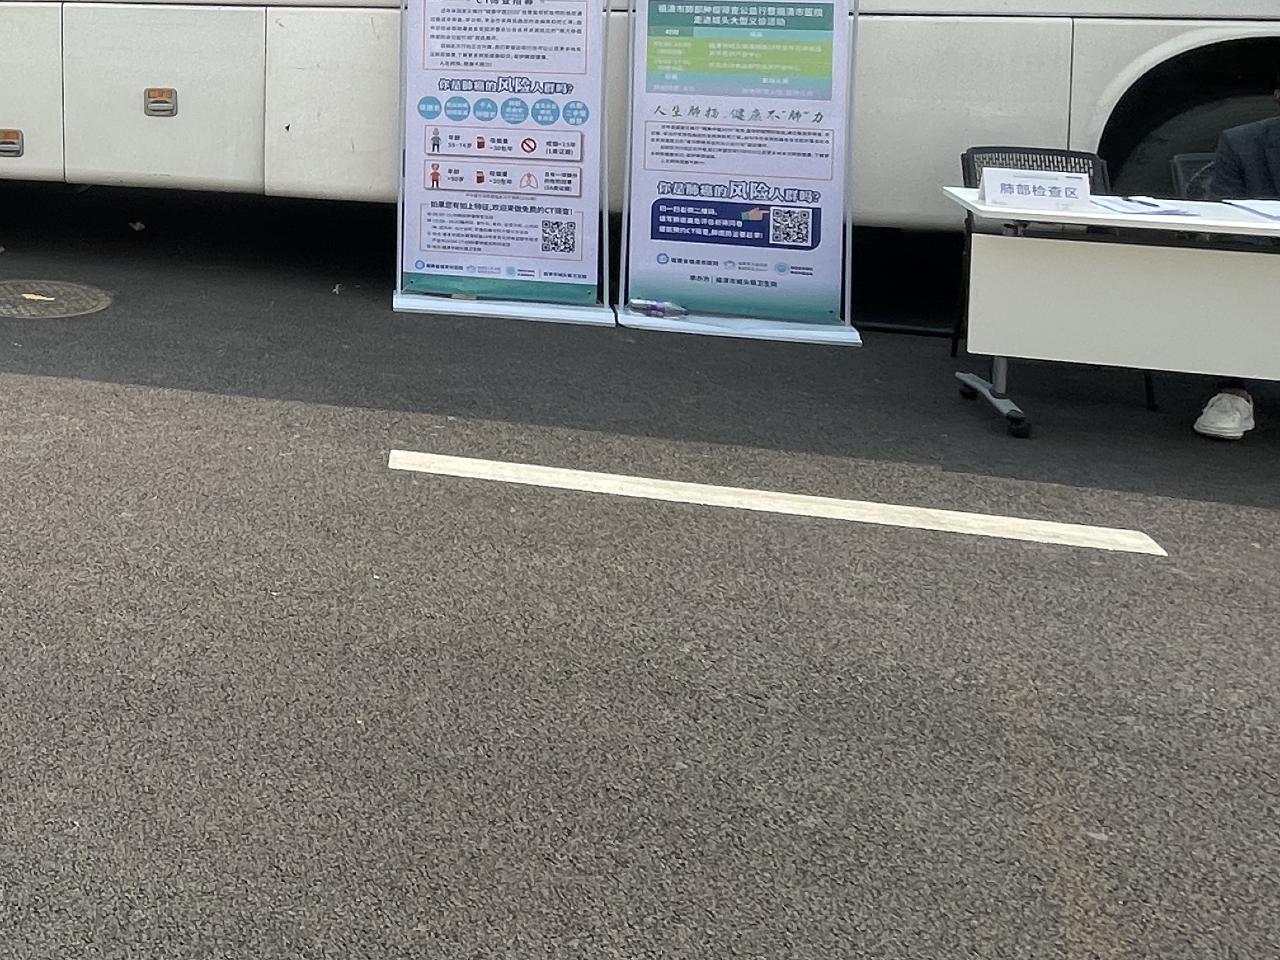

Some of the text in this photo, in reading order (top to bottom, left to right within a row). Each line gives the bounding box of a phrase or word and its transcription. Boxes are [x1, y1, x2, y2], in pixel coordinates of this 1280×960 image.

[657, 180, 822, 204] 你是肺癌的风险人群吗?
[1000, 182, 1080, 200] 肺部检查区
